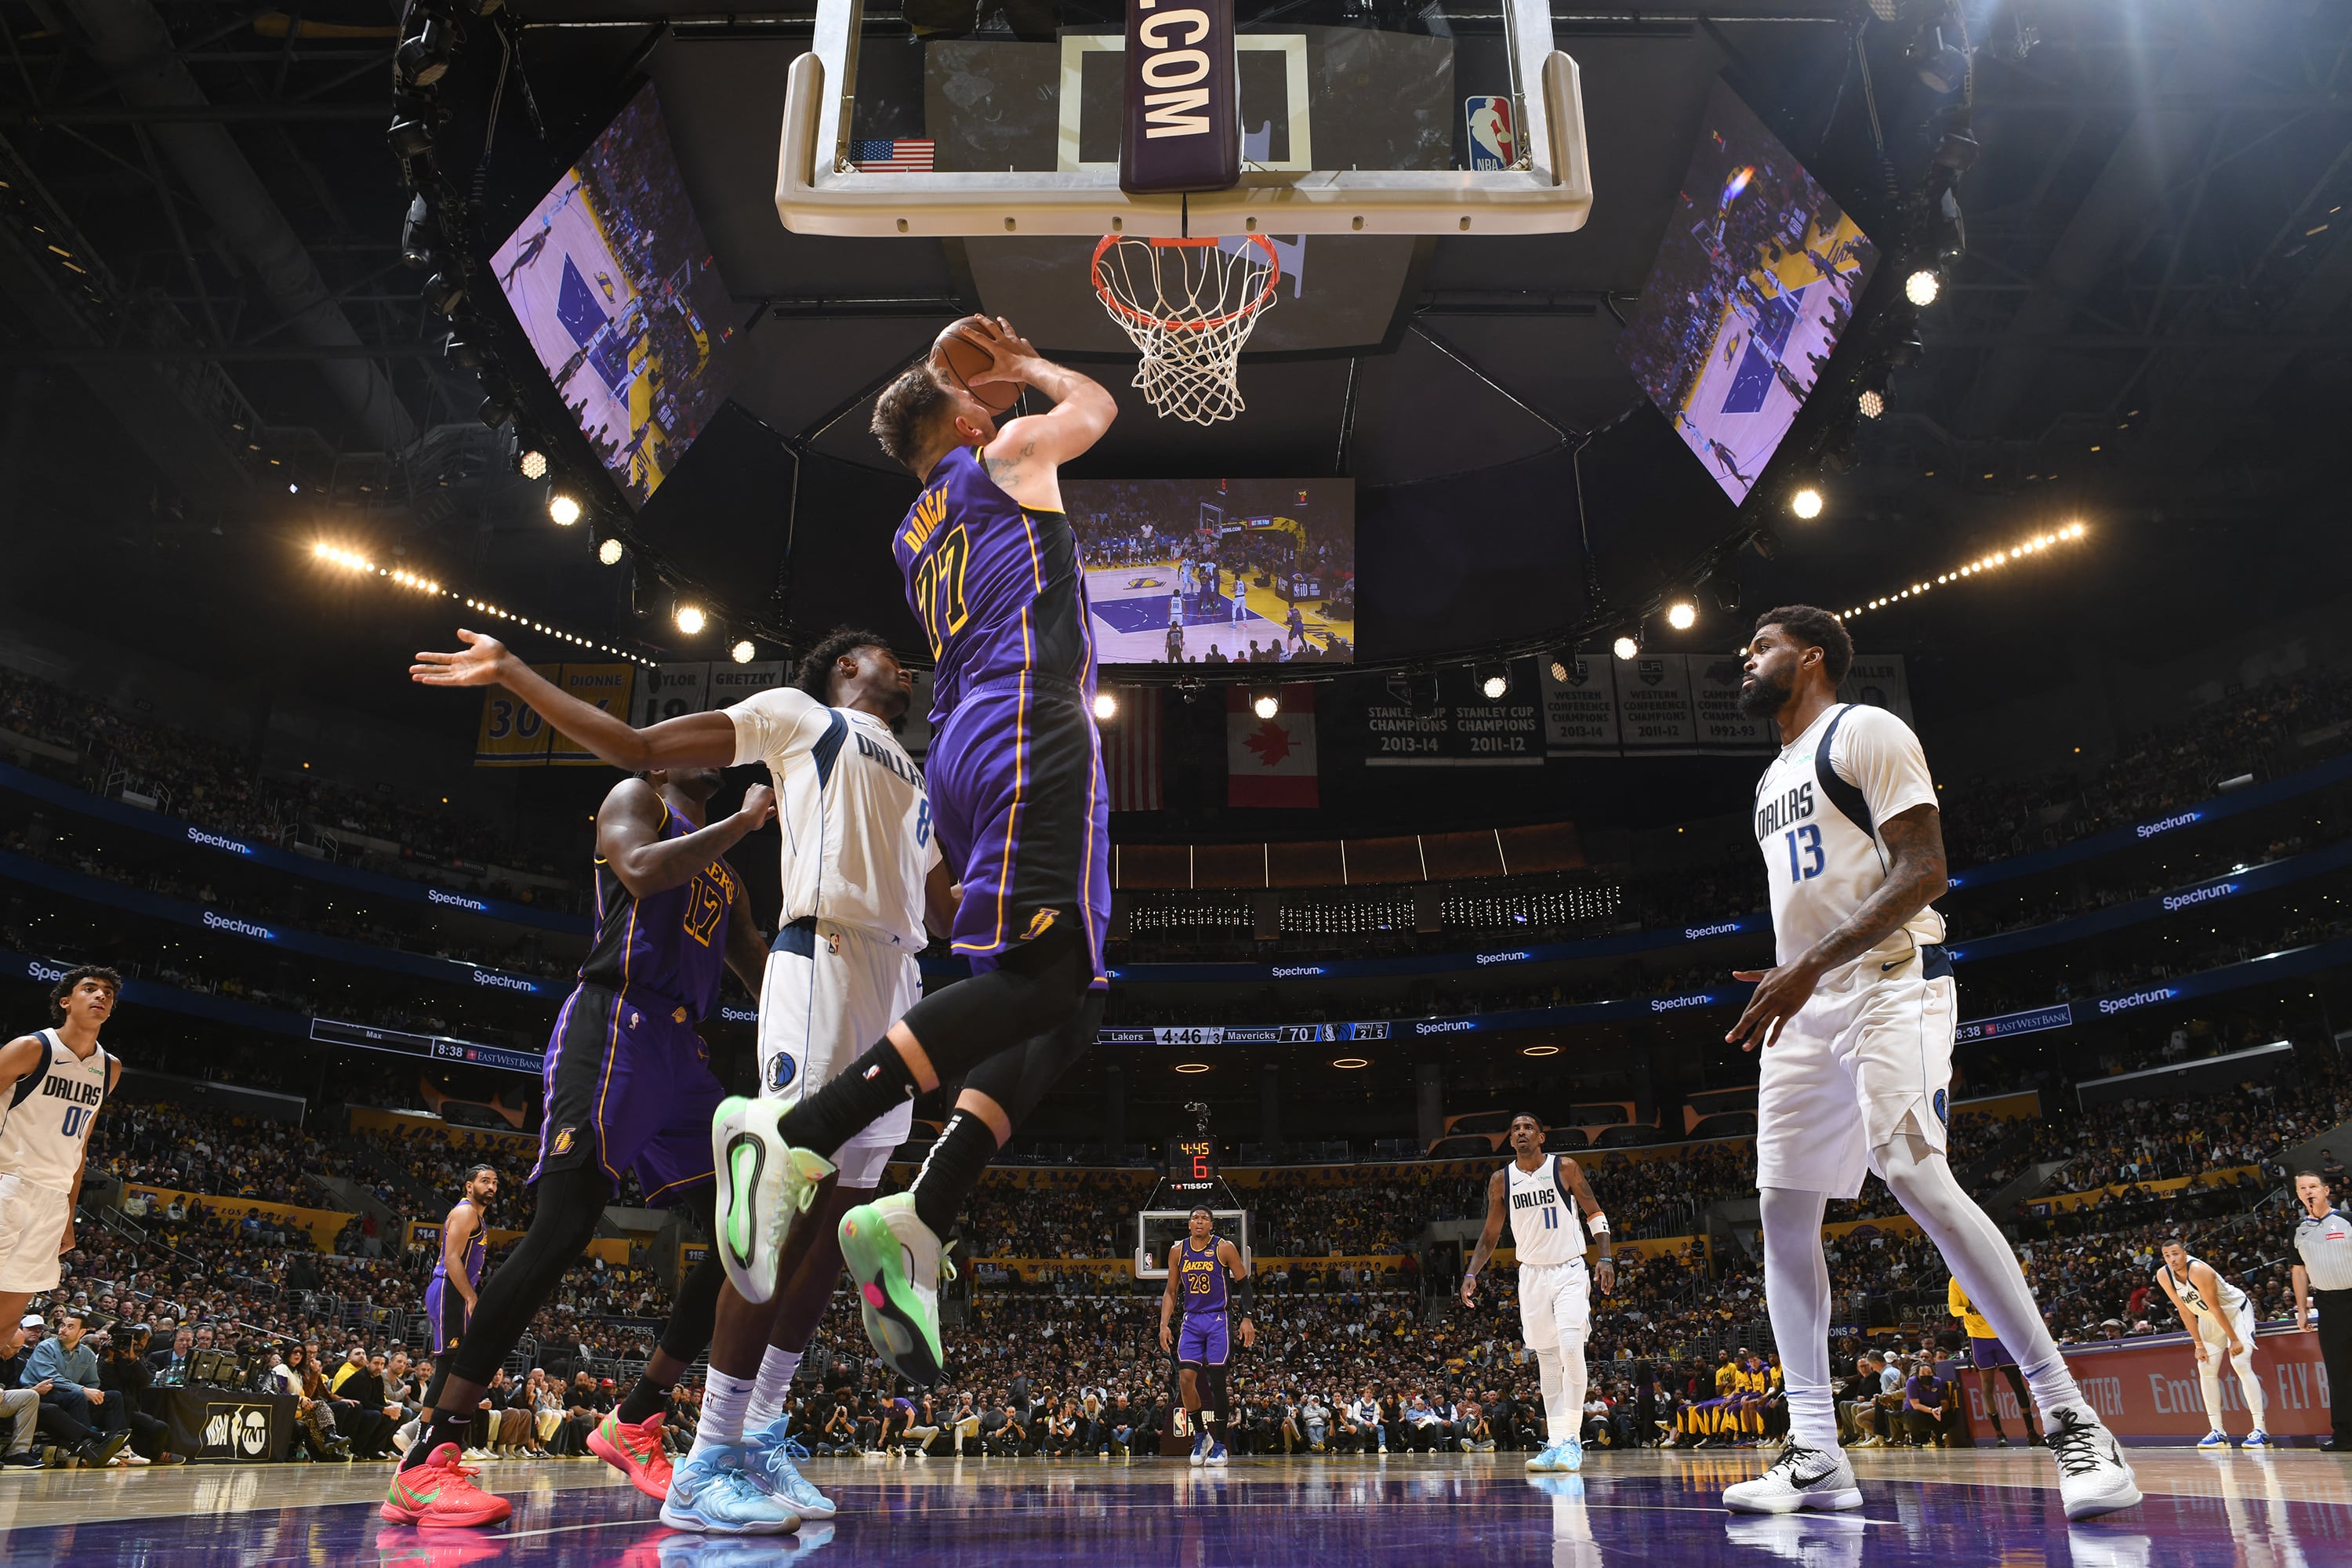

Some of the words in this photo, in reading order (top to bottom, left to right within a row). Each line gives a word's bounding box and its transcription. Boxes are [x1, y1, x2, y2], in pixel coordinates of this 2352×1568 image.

[1476, 158, 1499, 171] NBA
[916, 523, 969, 662] 77
[571, 674, 623, 686] DIONNE
[715, 672, 777, 685] GRETZKY
[1555, 691, 1601, 700] WESTERN
[1631, 690, 1678, 699] WESTERN
[1703, 690, 1740, 699] CAMPBE
[1368, 706, 1413, 718] STANLE
[1455, 706, 1507, 718] STANLEY
[1510, 706, 1534, 717] CUP
[1548, 702, 1611, 710] CONFERENCE
[1624, 701, 1687, 710] CONFERENCE
[1698, 700, 1738, 710] CONFER
[488, 699, 543, 739] 30
[1552, 713, 1610, 723] CHAMPIONS
[1628, 712, 1686, 722] CHAMPIONS
[1703, 712, 1742, 722] CHAMPI
[1369, 719, 1448, 731] CHAMPIONS
[1457, 719, 1536, 732] CHAMPIONS
[1560, 726, 1603, 737] 2013-14
[1638, 725, 1680, 738] 2011-12
[1709, 725, 1756, 738] 1992-93
[1381, 736, 1439, 752] 2013-14
[1470, 736, 1526, 752] 2011-12
[855, 731, 927, 795] DALLA
[1758, 780, 1815, 842] DALLAS
[916, 798, 931, 848] 8
[2136, 811, 2196, 838] Spectrum
[187, 827, 246, 854] Spectrum
[416, 851, 437, 860] TOYOTA
[1785, 823, 1826, 884] 13
[463, 861, 485, 872] TOYOTA
[428, 889, 481, 910] Spectrum
[2163, 882, 2232, 911] Spectrum
[683, 876, 724, 948] 17
[202, 911, 268, 939] Spectrum
[1685, 923, 1735, 939] Spectrum
[1475, 950, 1525, 965] Spectrum
[27, 961, 66, 982] Spec
[1272, 966, 1319, 978] Spectrum
[473, 970, 532, 992] Spectrum
[1651, 993, 1708, 1013] Spectrum
[2099, 986, 2171, 1014] Spectrum
[721, 1007, 758, 1021] Spectr
[366, 1029, 383, 1040] Max
[1289, 1027, 1308, 1041] 70
[1359, 1029, 1367, 1039] 2
[1376, 1029, 1383, 1038] 5
[1416, 1020, 1470, 1035] Spectrum
[1955, 1025, 1980, 1040] 8:38
[1112, 1031, 1144, 1042] Lakers
[1161, 1028, 1202, 1044] 4:46
[1212, 1033, 1221, 1044] 3
[1228, 1031, 1276, 1041] Mavericks
[437, 1044, 463, 1058] 8:38
[42, 1075, 101, 1106] DALLAS
[62, 1105, 93, 1140] 00
[1181, 1142, 1210, 1155] 4:45
[1192, 1156, 1207, 1178] 6
[1512, 1188, 1555, 1209] DALLAS
[1542, 1207, 1558, 1229] 11
[1181, 1259, 1214, 1272] LAKERS
[1188, 1273, 1211, 1295] 28
[1916, 1303, 1949, 1317] cryp
[1829, 1327, 1848, 1337] ONS
[2148, 1369, 2269, 1414] Emiat
[2277, 1362, 2310, 1410] FLY
[2079, 1377, 2124, 1416] ETTER
[205, 1413, 230, 1446] NBA
